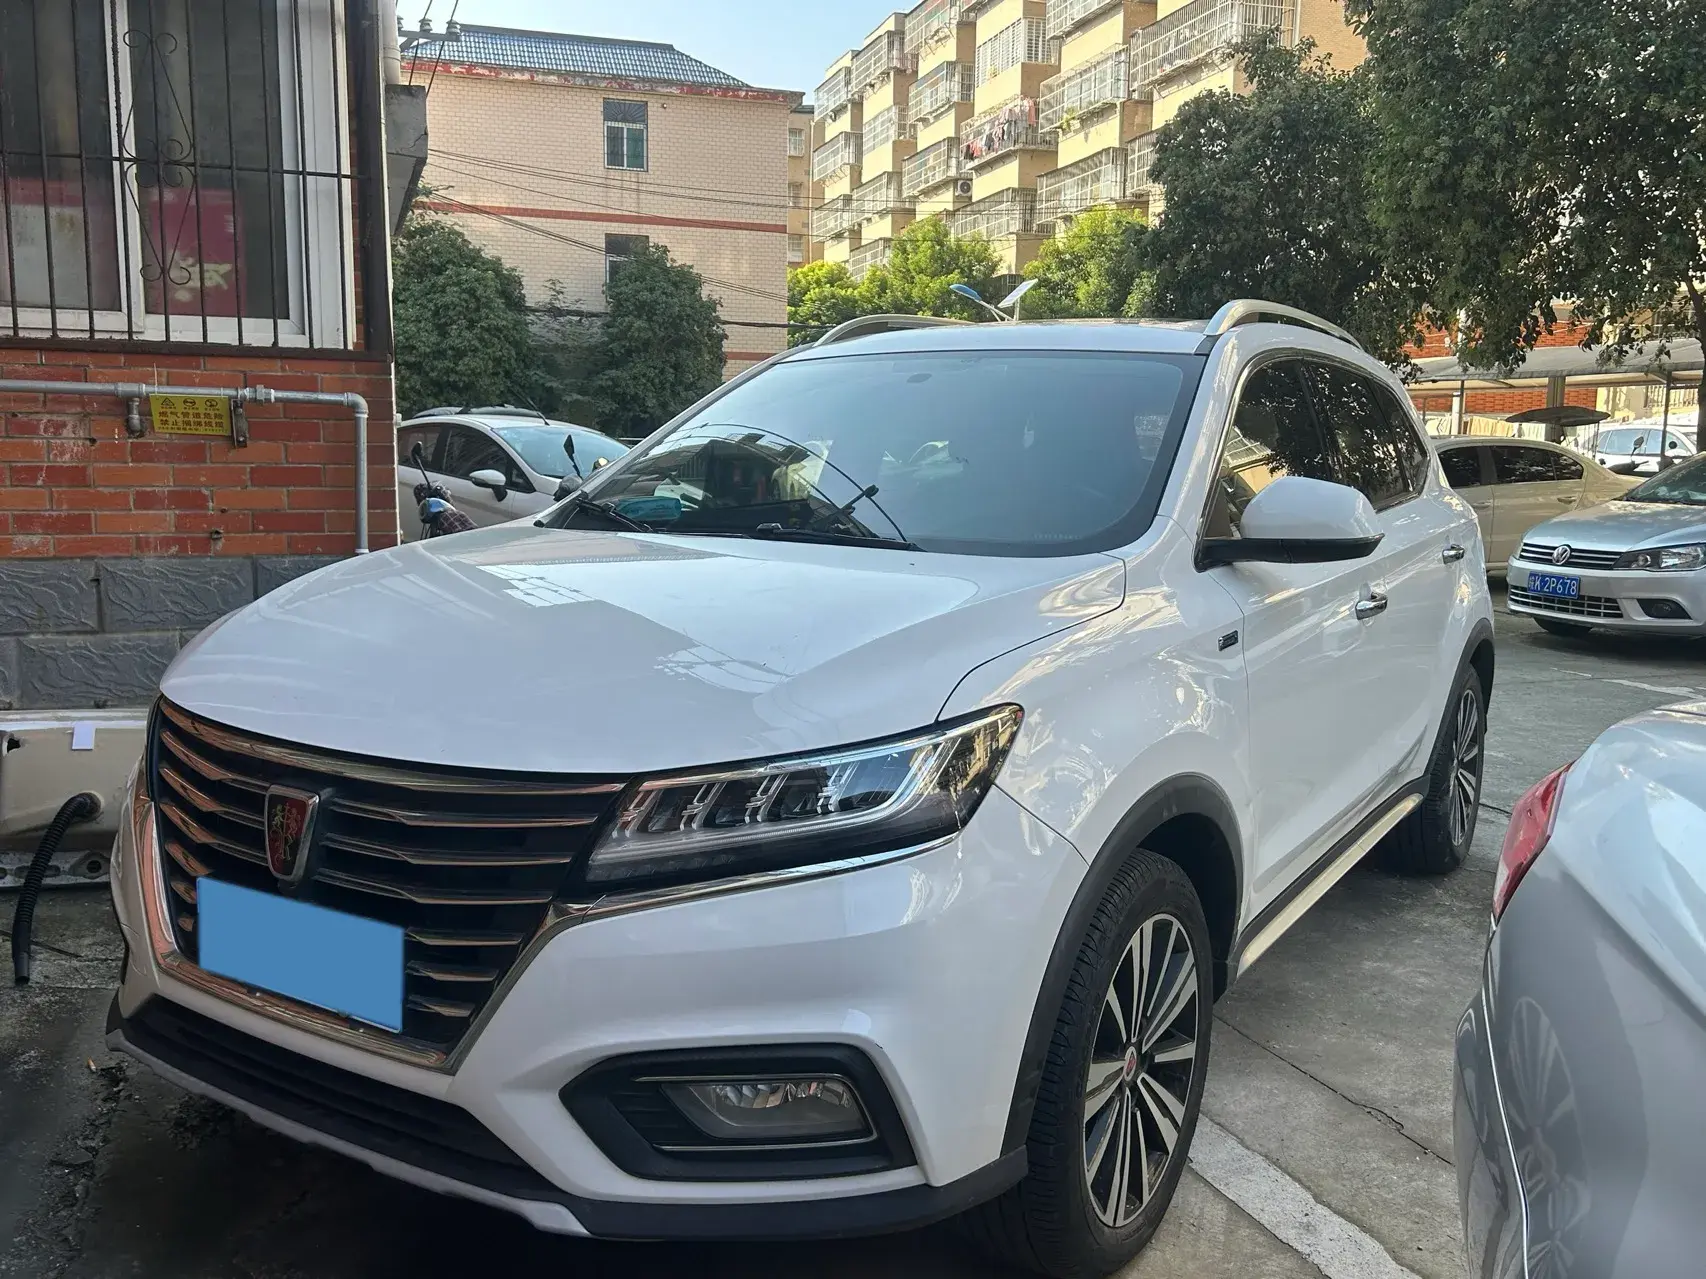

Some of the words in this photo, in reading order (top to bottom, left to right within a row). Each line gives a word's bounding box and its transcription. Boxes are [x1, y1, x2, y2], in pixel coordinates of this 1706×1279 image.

[158, 411, 224, 420] 燃气管道危险
